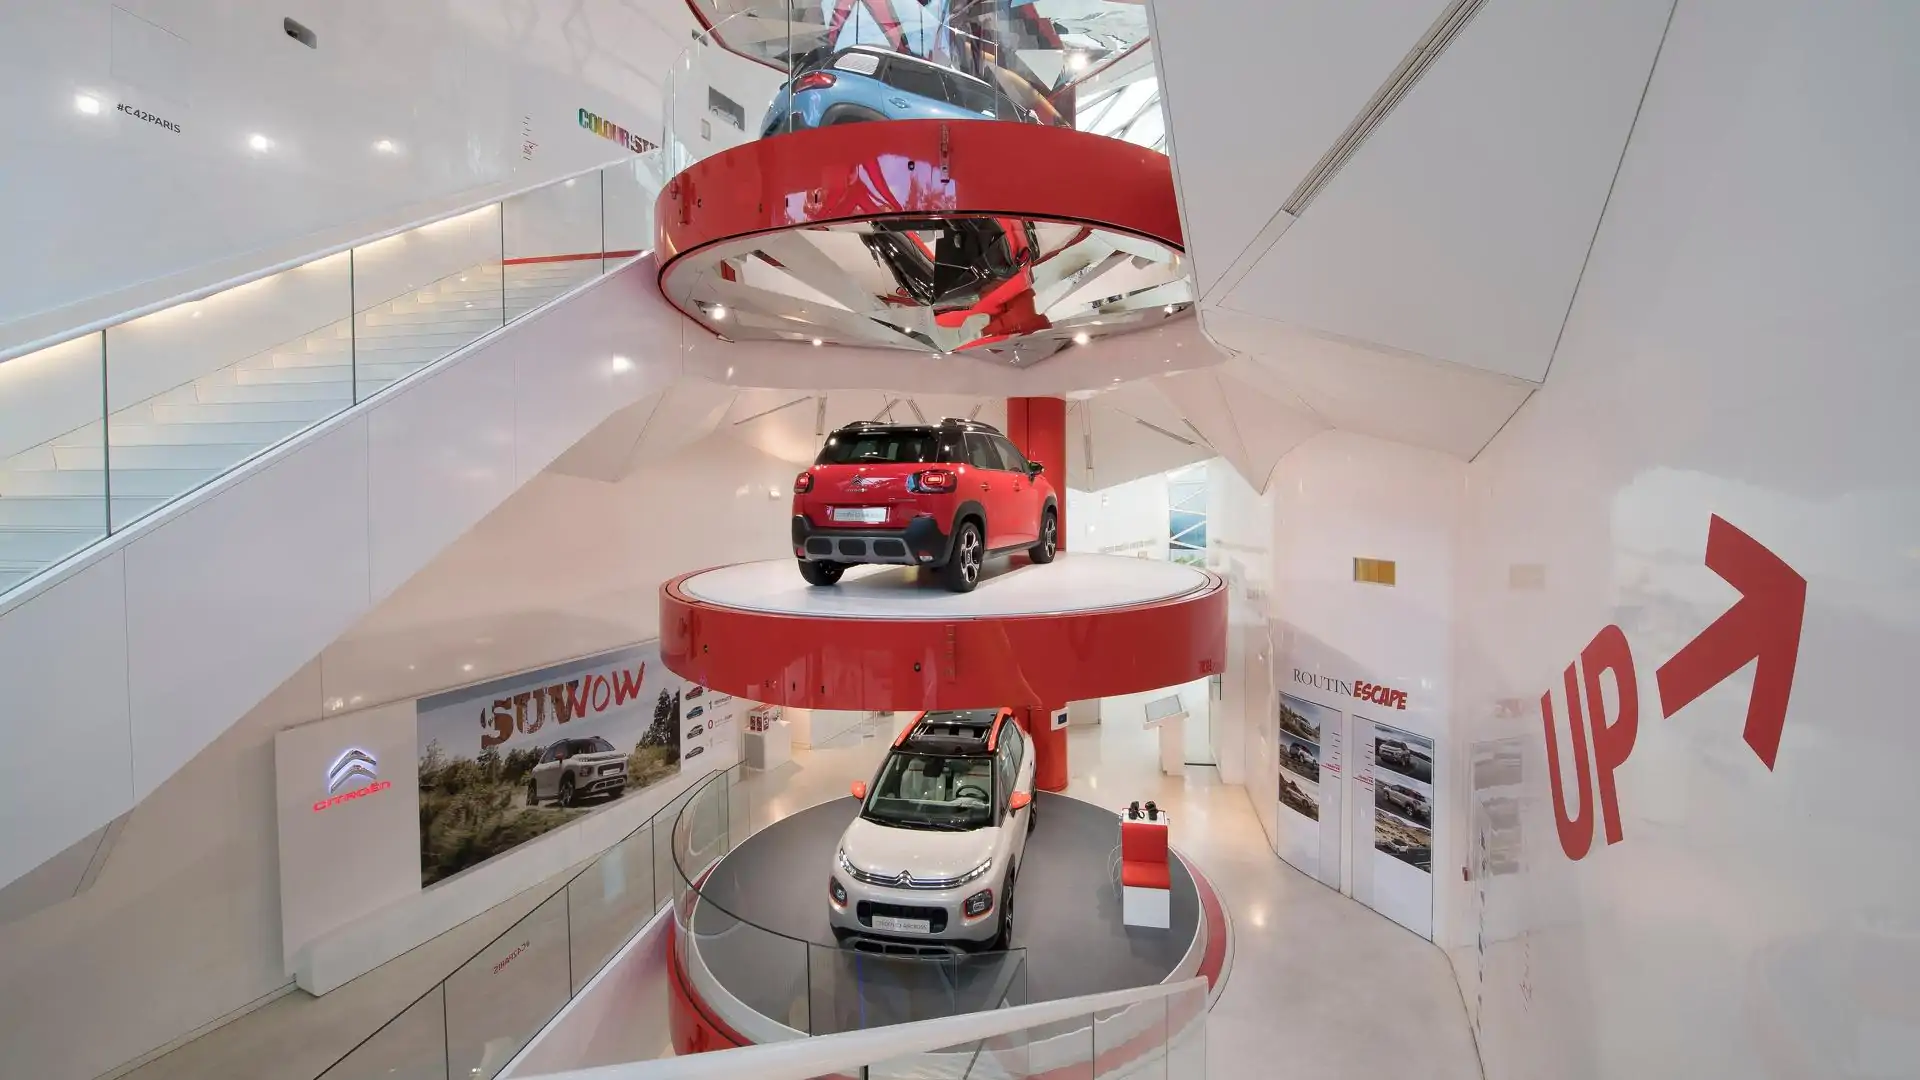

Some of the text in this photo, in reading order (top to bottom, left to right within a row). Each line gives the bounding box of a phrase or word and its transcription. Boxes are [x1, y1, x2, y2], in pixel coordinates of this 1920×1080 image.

[116, 103, 181, 133] #C42PARIS
[481, 661, 645, 749] SUWOW
[1540, 624, 1639, 862] UP
